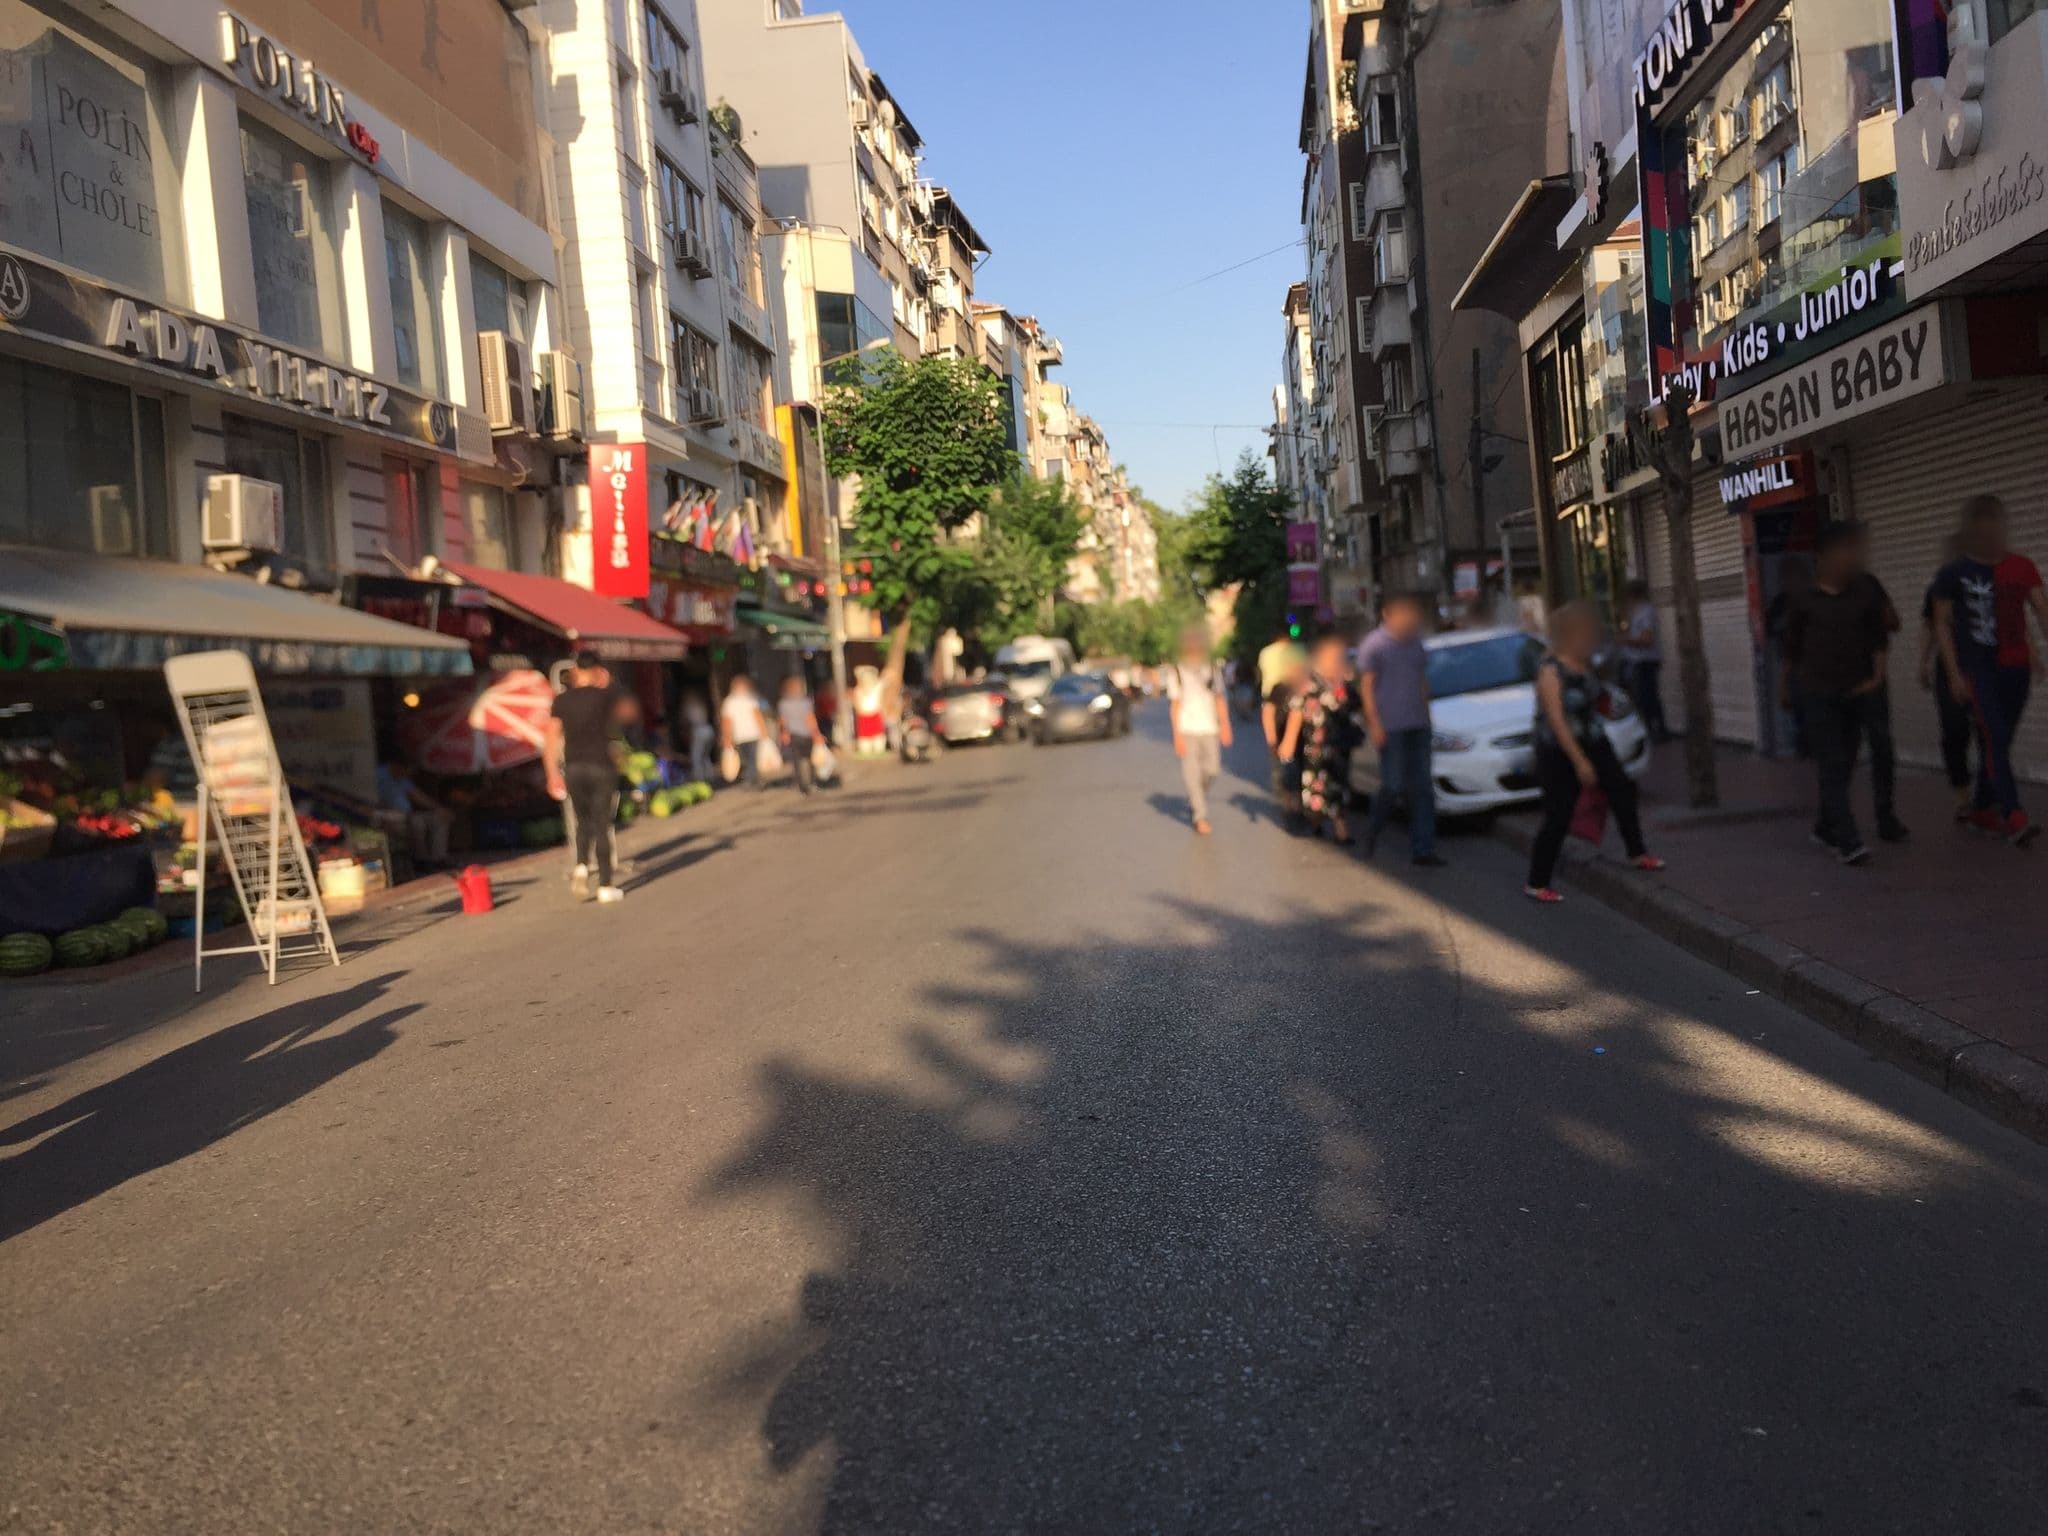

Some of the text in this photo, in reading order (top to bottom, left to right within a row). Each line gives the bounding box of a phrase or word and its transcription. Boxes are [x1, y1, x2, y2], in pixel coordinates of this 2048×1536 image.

[61, 170, 158, 237] CHOLE
[110, 160, 124, 186] &
[105, 298, 391, 426] ADA YILDIZ
[1723, 323, 1769, 378] Kids
[1795, 258, 1881, 341] Junior
[1725, 370, 1821, 451] HASAN
[1831, 320, 1927, 410] BABY
[1719, 460, 1794, 503] WANHILL
